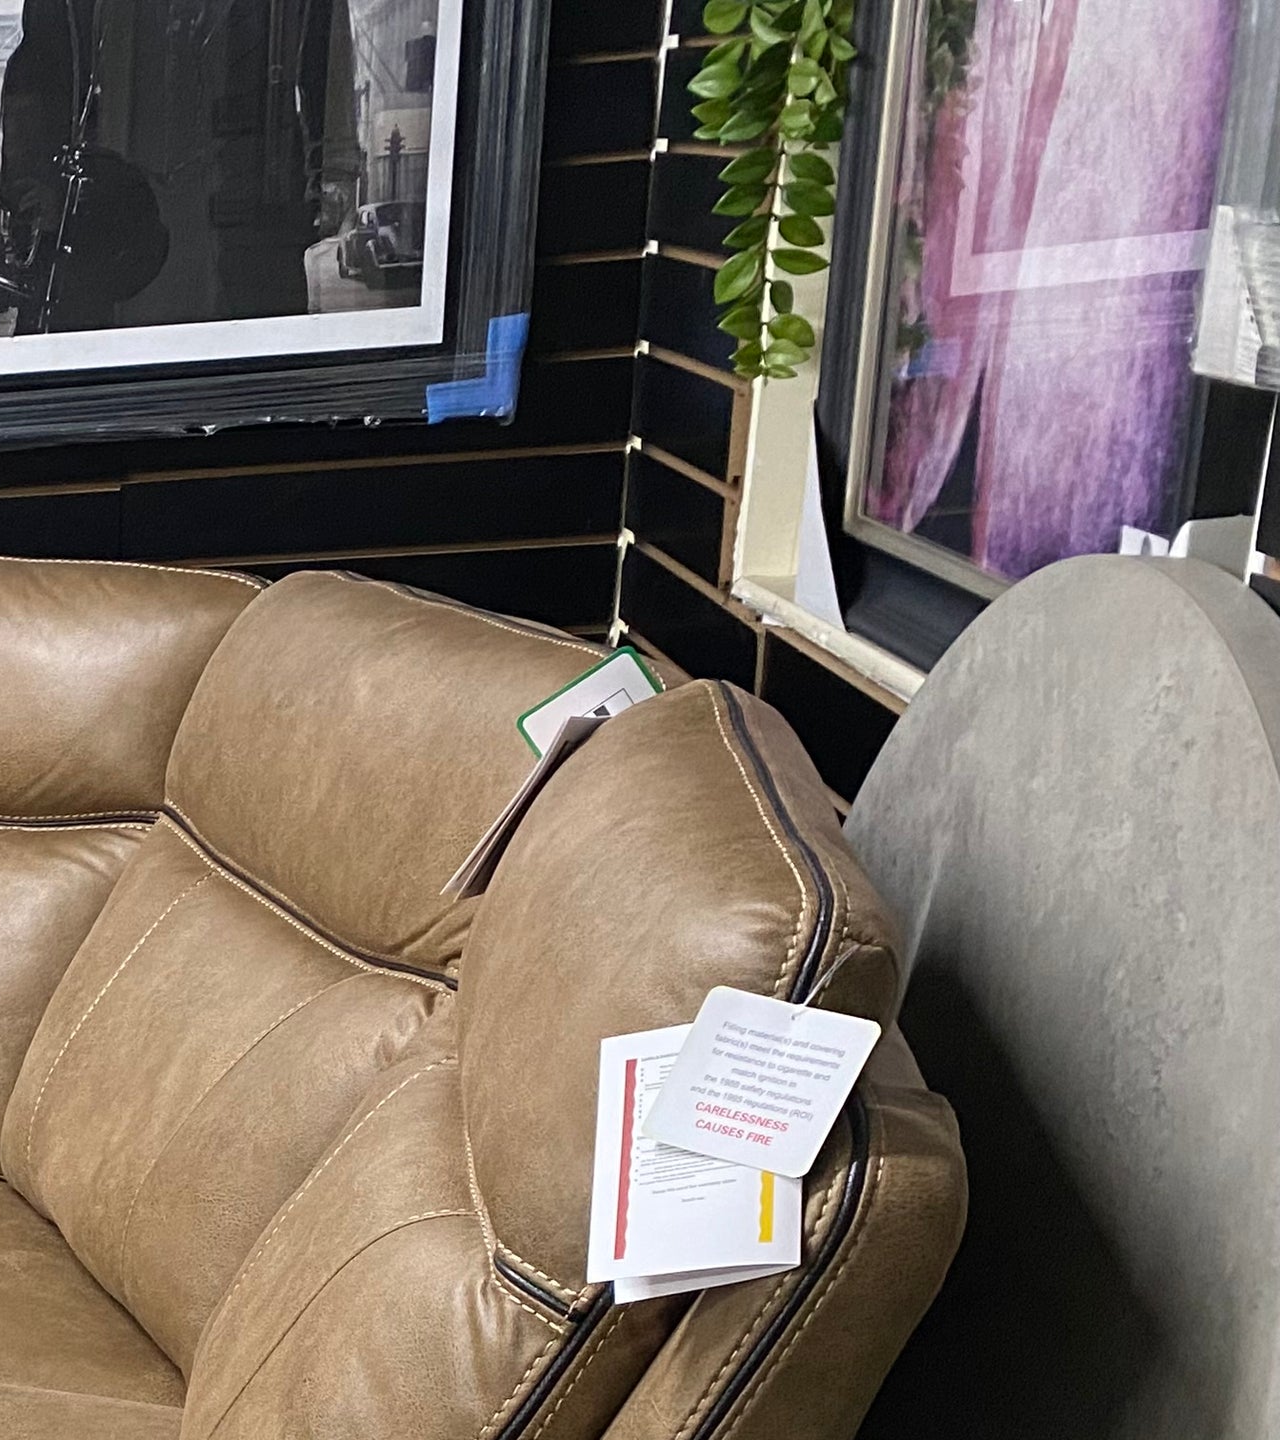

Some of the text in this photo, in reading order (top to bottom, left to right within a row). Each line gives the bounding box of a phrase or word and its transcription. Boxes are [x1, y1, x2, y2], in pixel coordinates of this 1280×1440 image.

[749, 1043, 770, 1054] meet
[772, 1048, 785, 1057] the
[792, 1040, 809, 1048] and
[810, 1044, 845, 1058] covering
[712, 1047, 723, 1056] for
[814, 1073, 831, 1081] and
[731, 1068, 757, 1078] match
[704, 1074, 717, 1082] the
[741, 1084, 766, 1096] safety
[690, 1086, 706, 1094] and
[707, 1089, 721, 1097] the
[744, 1099, 788, 1114] regulations
[789, 1109, 813, 1121] (ROI)
[695, 1101, 789, 1132] CARELESSNESS
[695, 1119, 773, 1146] CAUSES FIRE
